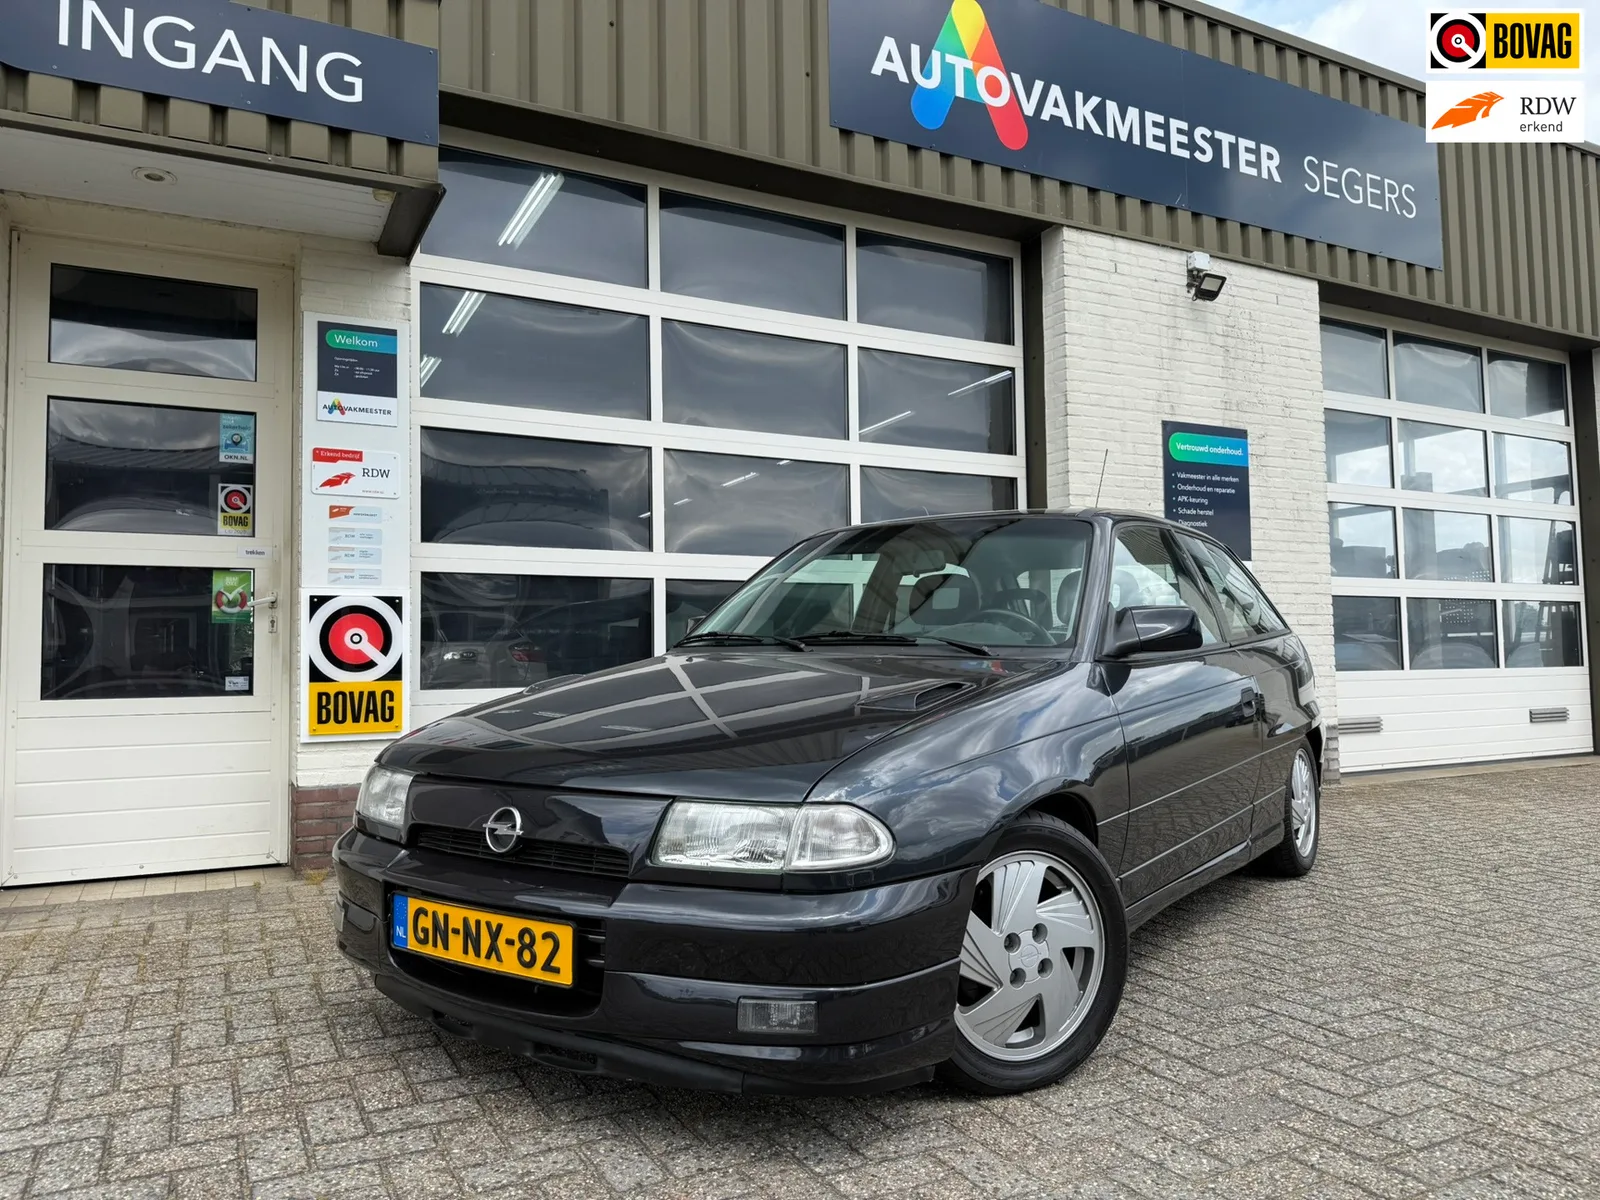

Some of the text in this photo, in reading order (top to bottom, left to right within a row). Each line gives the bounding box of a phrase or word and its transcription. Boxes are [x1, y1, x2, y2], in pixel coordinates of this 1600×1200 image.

[58, 0, 364, 103] INGANG
[870, 35, 1417, 219] AUTOVAKMEESTER SEGERS
[334, 334, 378, 348] Welkom
[322, 403, 392, 416] AUTOVAKMEESTER
[320, 450, 360, 460] Erkend bedrijf
[1176, 442, 1244, 456] Vertrouwd onderhoud.
[361, 467, 391, 479] RDW
[1177, 471, 1206, 480] Vakmeester
[1212, 474, 1221, 482] alle
[1177, 483, 1206, 492] Onderhoud
[1214, 487, 1236, 495] reparatie
[1177, 495, 1209, 505] APK-keuring
[1178, 507, 1214, 516] Schade herstel
[223, 515, 249, 527] BOVAG
[1178, 519, 1208, 528] Diagnostiek
[316, 689, 395, 725] BOVAG
[395, 925, 407, 938] NL
[412, 906, 562, 975] GN-NX-82
